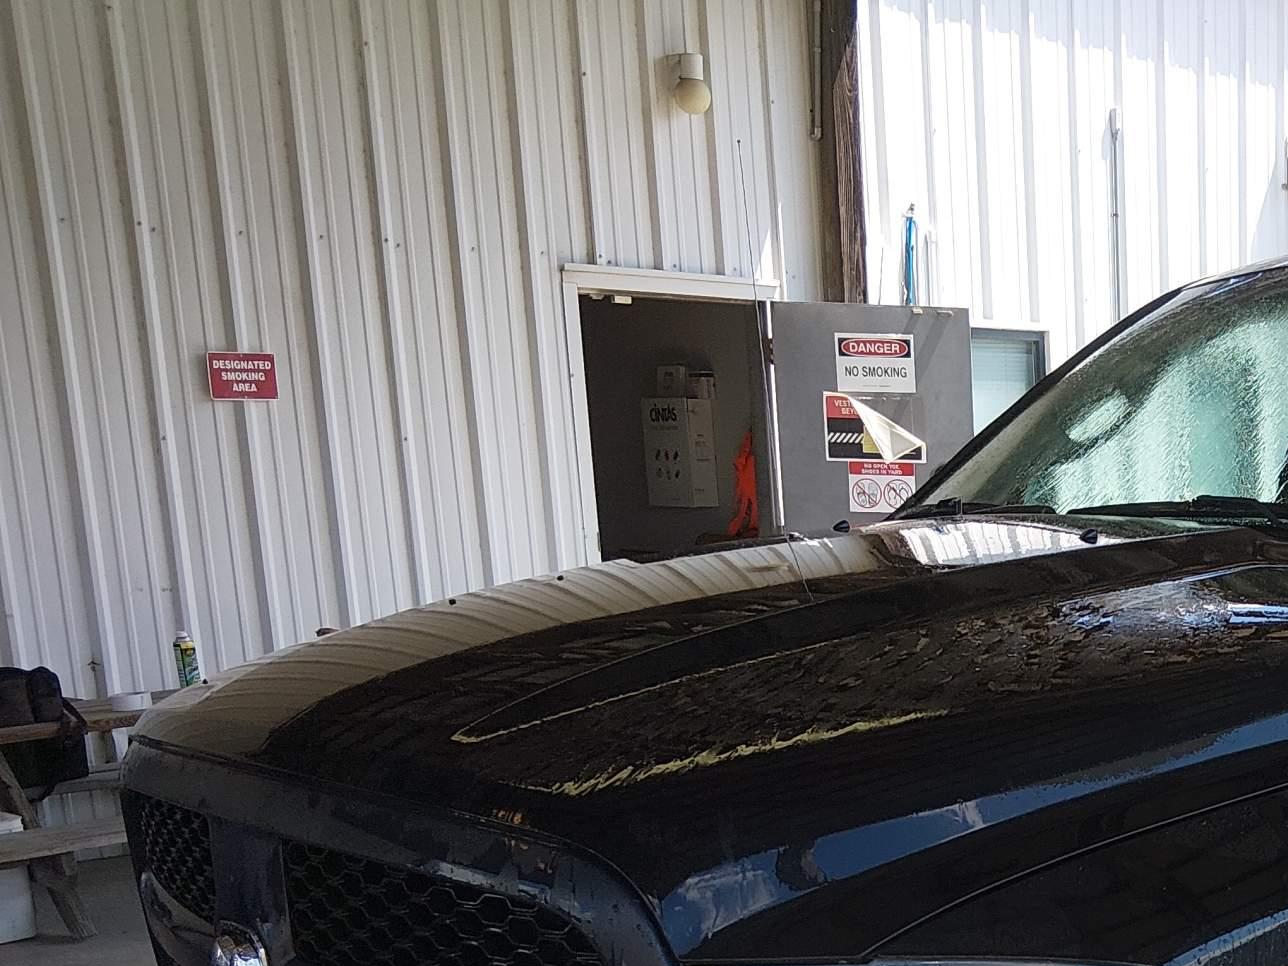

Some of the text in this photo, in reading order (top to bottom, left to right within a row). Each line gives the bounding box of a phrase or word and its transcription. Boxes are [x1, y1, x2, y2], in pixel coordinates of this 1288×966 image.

[849, 342, 900, 354] DANGER
[212, 360, 272, 370] DESIGNATED
[221, 371, 266, 381] SMOKING
[844, 365, 908, 378] NO SMOKING
[232, 382, 258, 392] AREA
